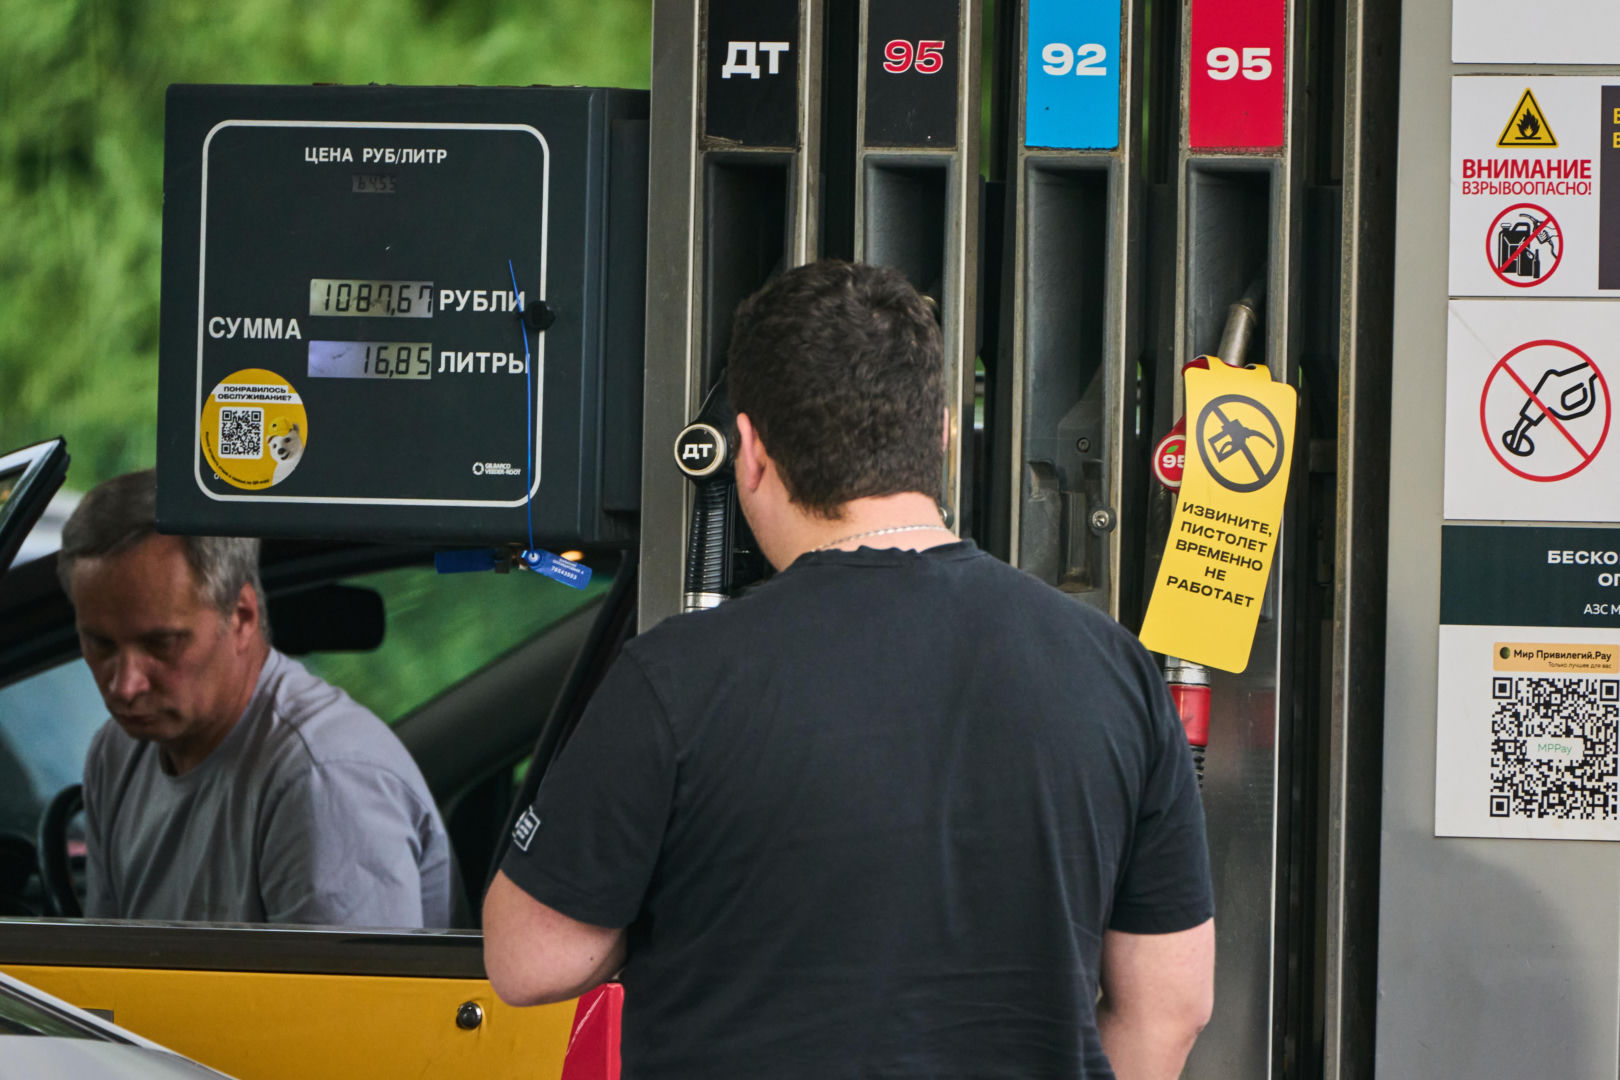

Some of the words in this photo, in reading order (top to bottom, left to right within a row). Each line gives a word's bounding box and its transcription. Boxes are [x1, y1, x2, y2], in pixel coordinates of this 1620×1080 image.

[722, 41, 789, 79] ДТ
[882, 38, 945, 75] 95
[1041, 42, 1107, 77] 92
[1206, 47, 1272, 81] 95
[305, 147, 353, 165] ЦЕНА
[362, 148, 448, 164] РУБ/ЛИТР
[1462, 159, 1592, 179] ВНИМАНИЕ
[1462, 181, 1592, 195] ВЗРЫВООПАСНО!
[439, 289, 526, 312] РУБЛИ
[208, 316, 302, 339] СУММА
[364, 345, 431, 375] 16,85
[438, 351, 530, 374] ЛИТРЫ
[217, 393, 292, 401] ОБСЛУЖИВАНИЕ?
[223, 386, 286, 394] ПОНРАВИЛОСЬ
[682, 443, 713, 460] ДТ
[1182, 501, 1272, 537] ИЗВИНИТЕ,
[1180, 521, 1268, 553] ПИСТОЛЕТ
[1175, 539, 1263, 572] ВРЕМЕННО
[1204, 566, 1227, 581] НЕ
[1166, 575, 1254, 607] РАБОТАЕТ
[1583, 603, 1609, 615] АЗС
[1513, 650, 1534, 662] Мир
[1536, 650, 1612, 662] Привилегий.Pay
[1537, 743, 1573, 755] MPPay
